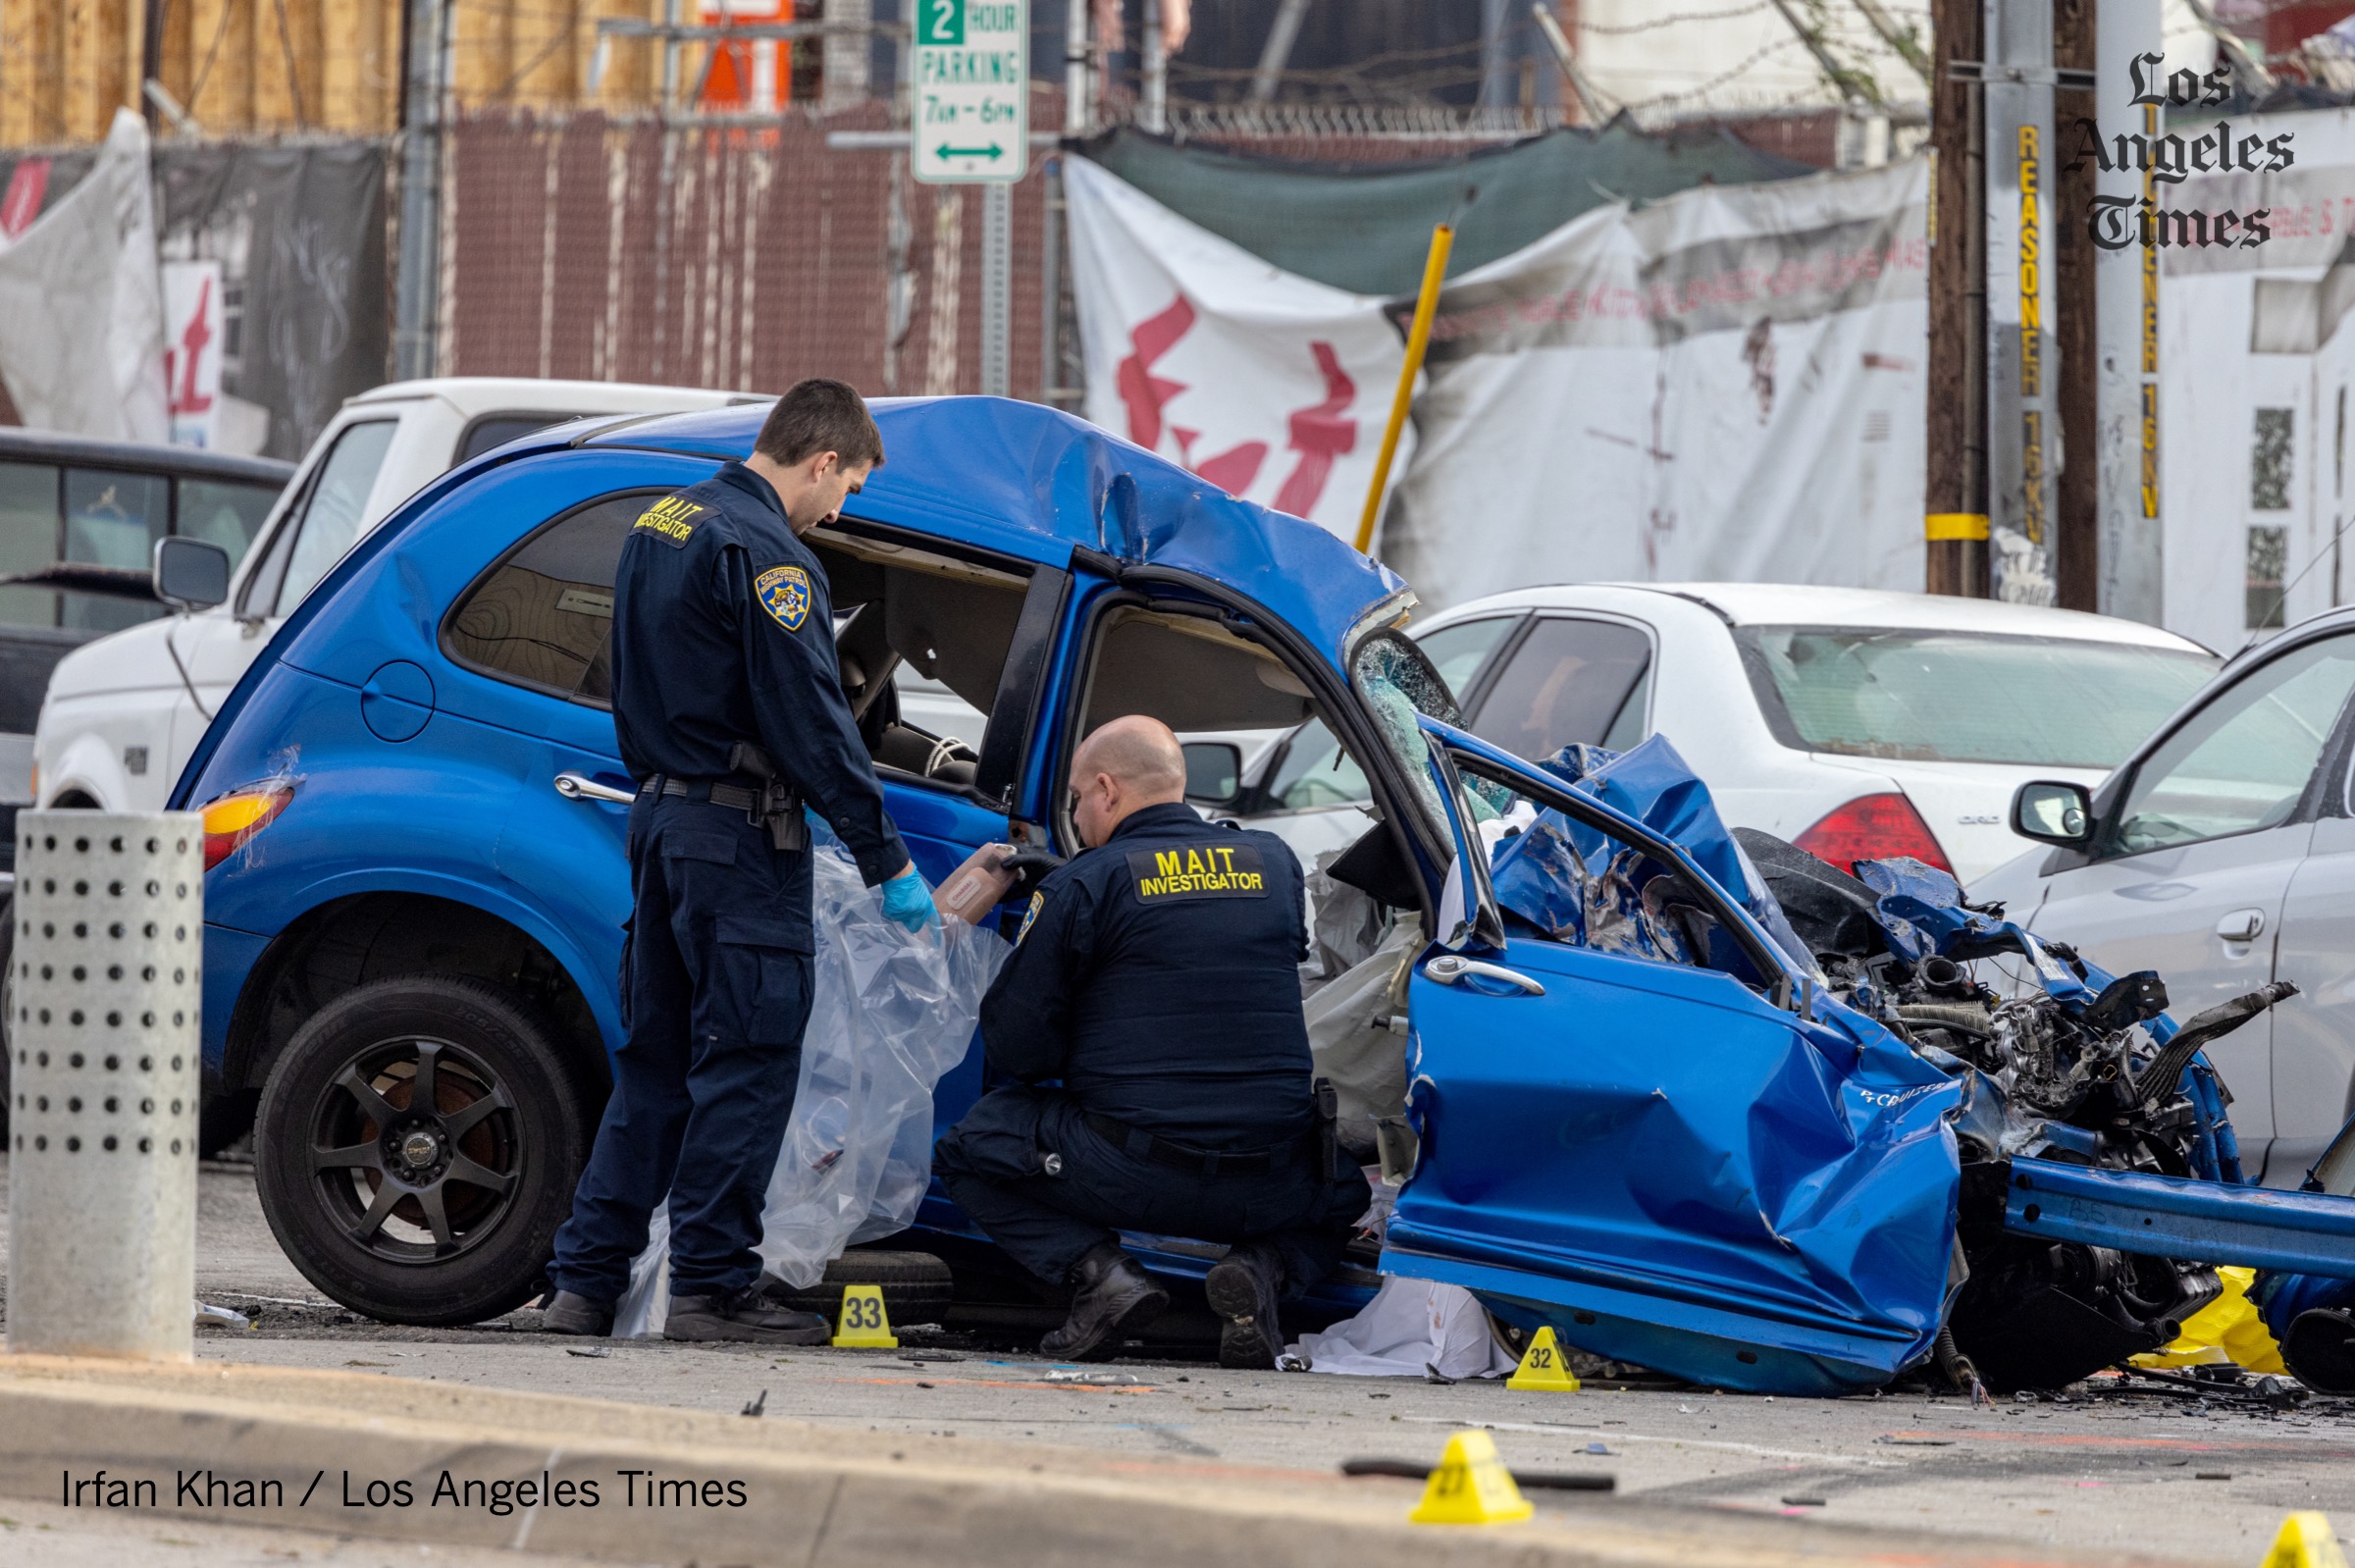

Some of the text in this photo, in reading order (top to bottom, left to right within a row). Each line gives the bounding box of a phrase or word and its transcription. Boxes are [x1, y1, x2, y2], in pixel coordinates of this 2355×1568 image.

[931, 0, 1017, 39] 2 HOUR
[922, 51, 1018, 84] PARKING
[2017, 125, 2041, 395] REASONER
[650, 496, 705, 521] MAIT
[759, 569, 802, 585] CALIFORNIA
[759, 576, 784, 596] HIGHWAY
[1155, 848, 1234, 877] MAIT
[1140, 872, 1263, 896] INVESTIGATOR
[1876, 1082, 1946, 1107] CRUISER
[846, 1296, 882, 1330] 33
[1529, 1347, 1552, 1369] 32
